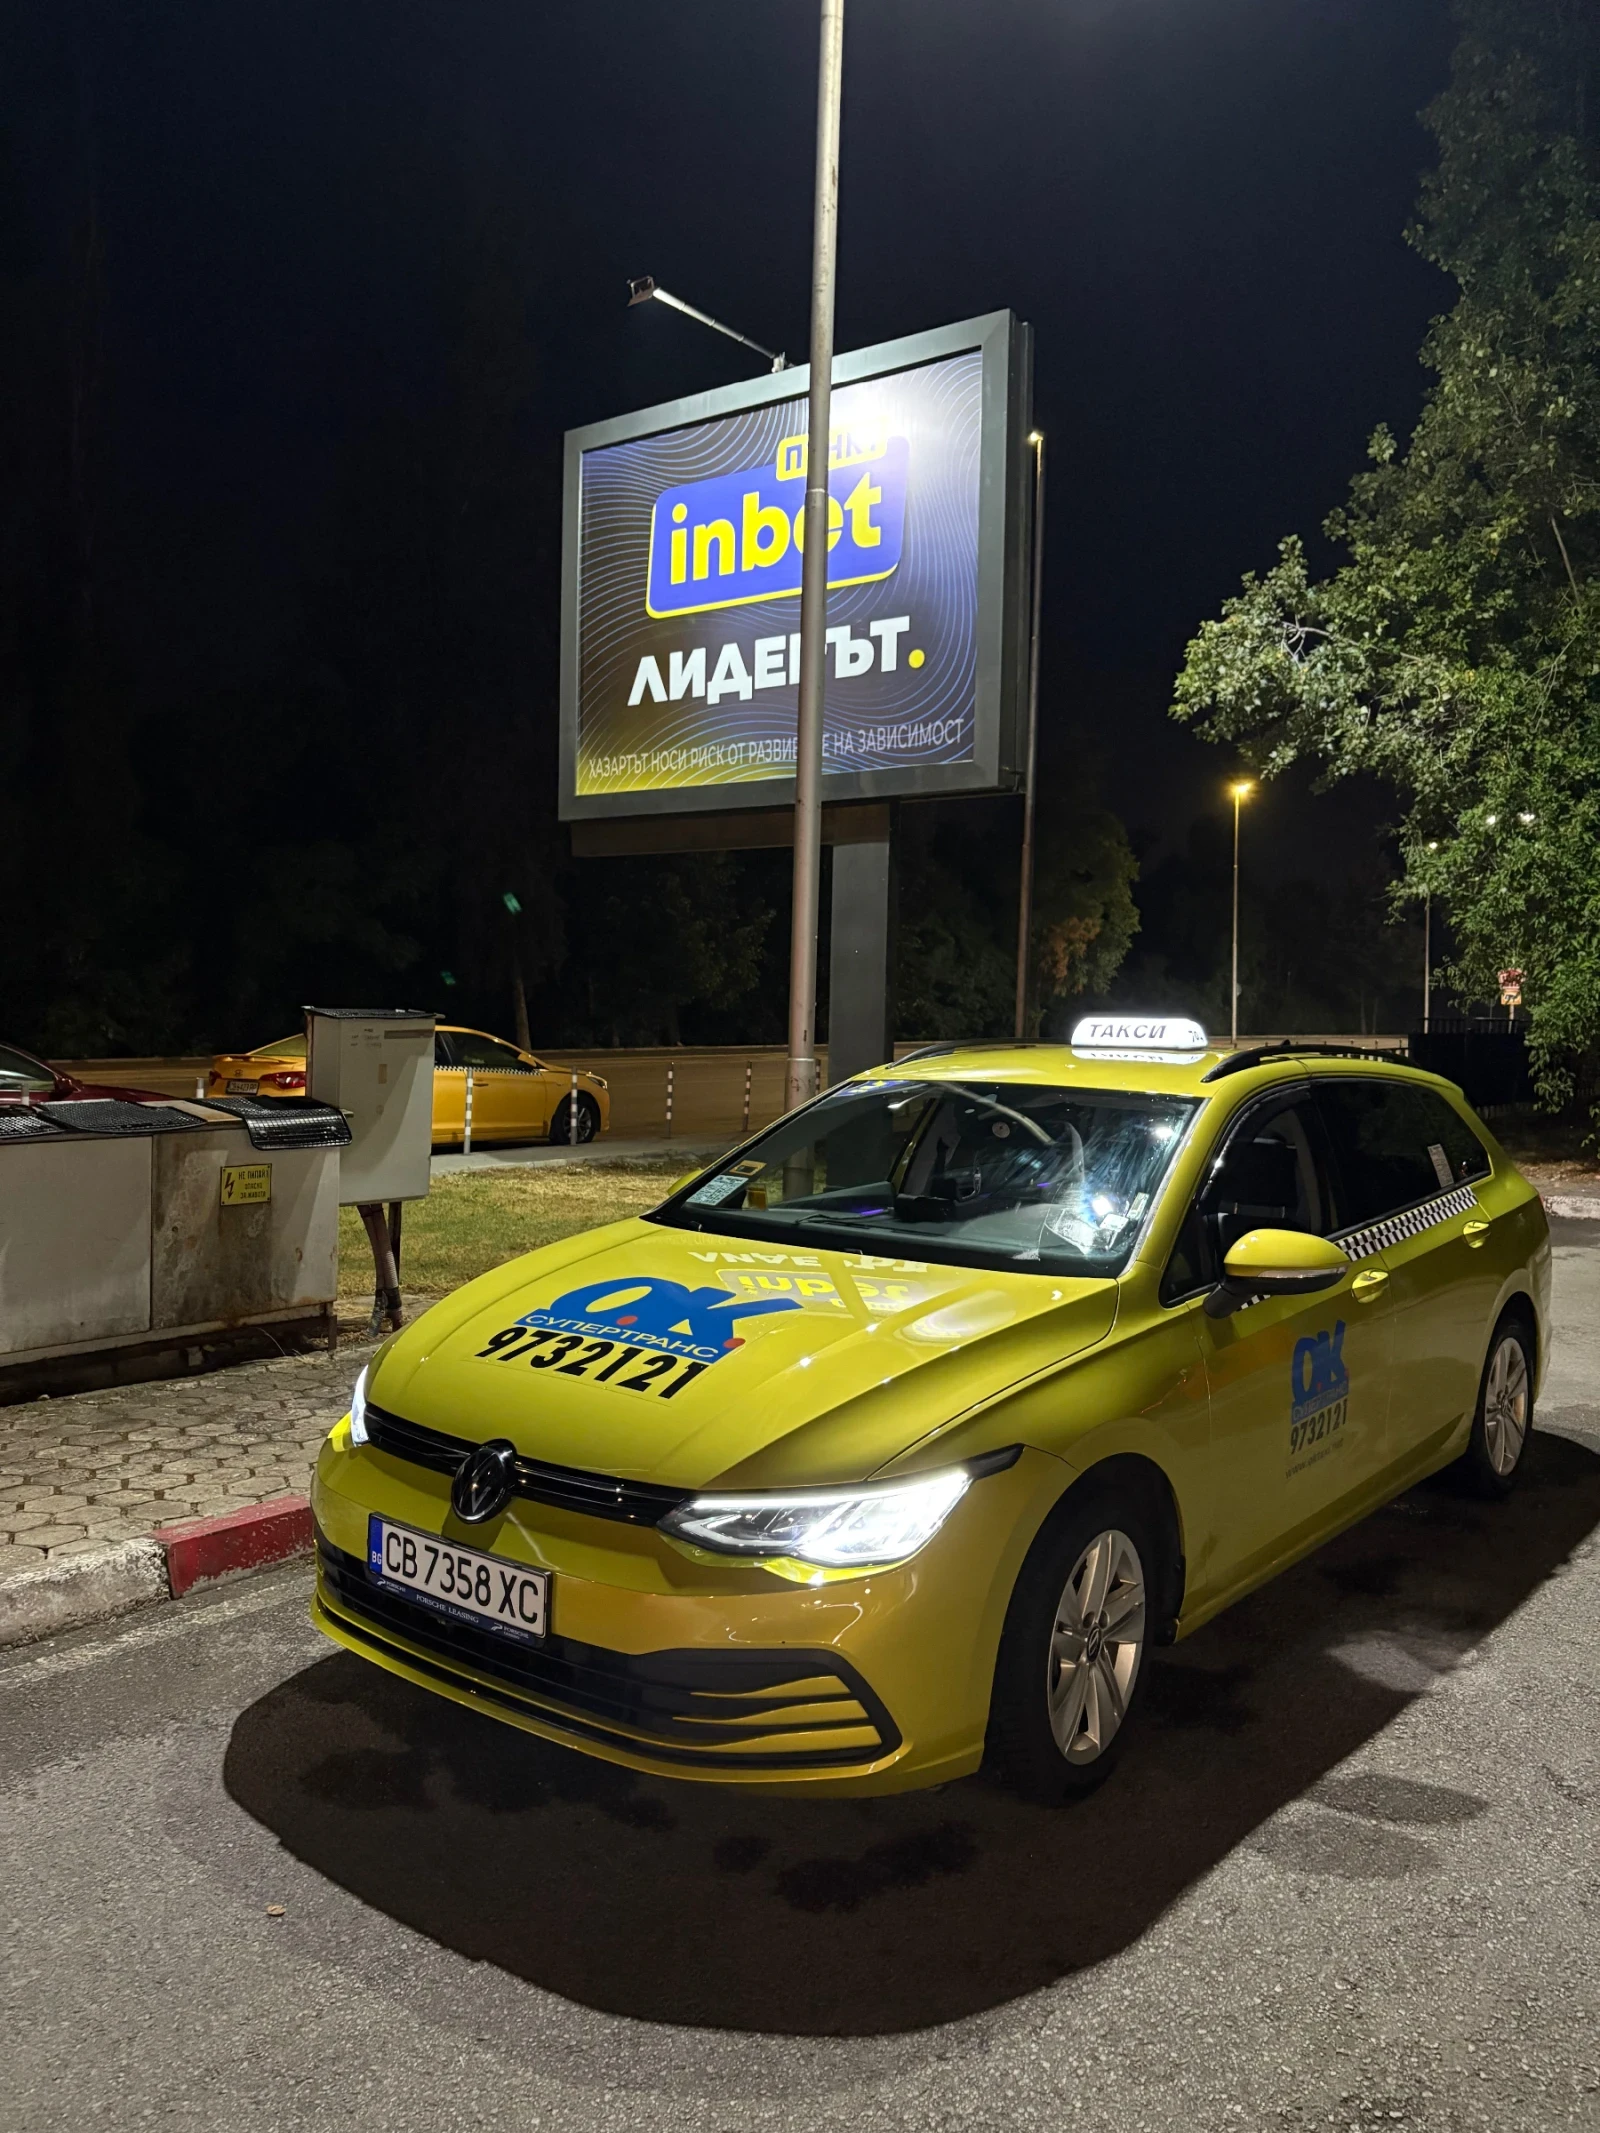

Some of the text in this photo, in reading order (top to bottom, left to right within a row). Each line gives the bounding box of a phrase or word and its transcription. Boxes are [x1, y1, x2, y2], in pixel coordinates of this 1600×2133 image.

[588, 753, 648, 779] ХАЗАРТЪТ
[651, 749, 687, 772] НОСИ
[691, 744, 724, 768] РИСК
[727, 742, 747, 765] ОТ
[834, 731, 855, 755] НА
[857, 718, 964, 754] ЗАВИСИМОСТ
[1090, 1024, 1167, 1039] ТАКСИ
[238, 1171, 246, 1180] НЕ
[525, 1314, 719, 1359] СУПЕРТРАНС
[474, 1326, 710, 1400] 9732121
[1290, 1398, 1349, 1455] 9732121
[371, 1551, 382, 1565] BG
[386, 1531, 539, 1624] CB 7358 XC
[416, 1594, 479, 1624] PORSCHE LEASING
